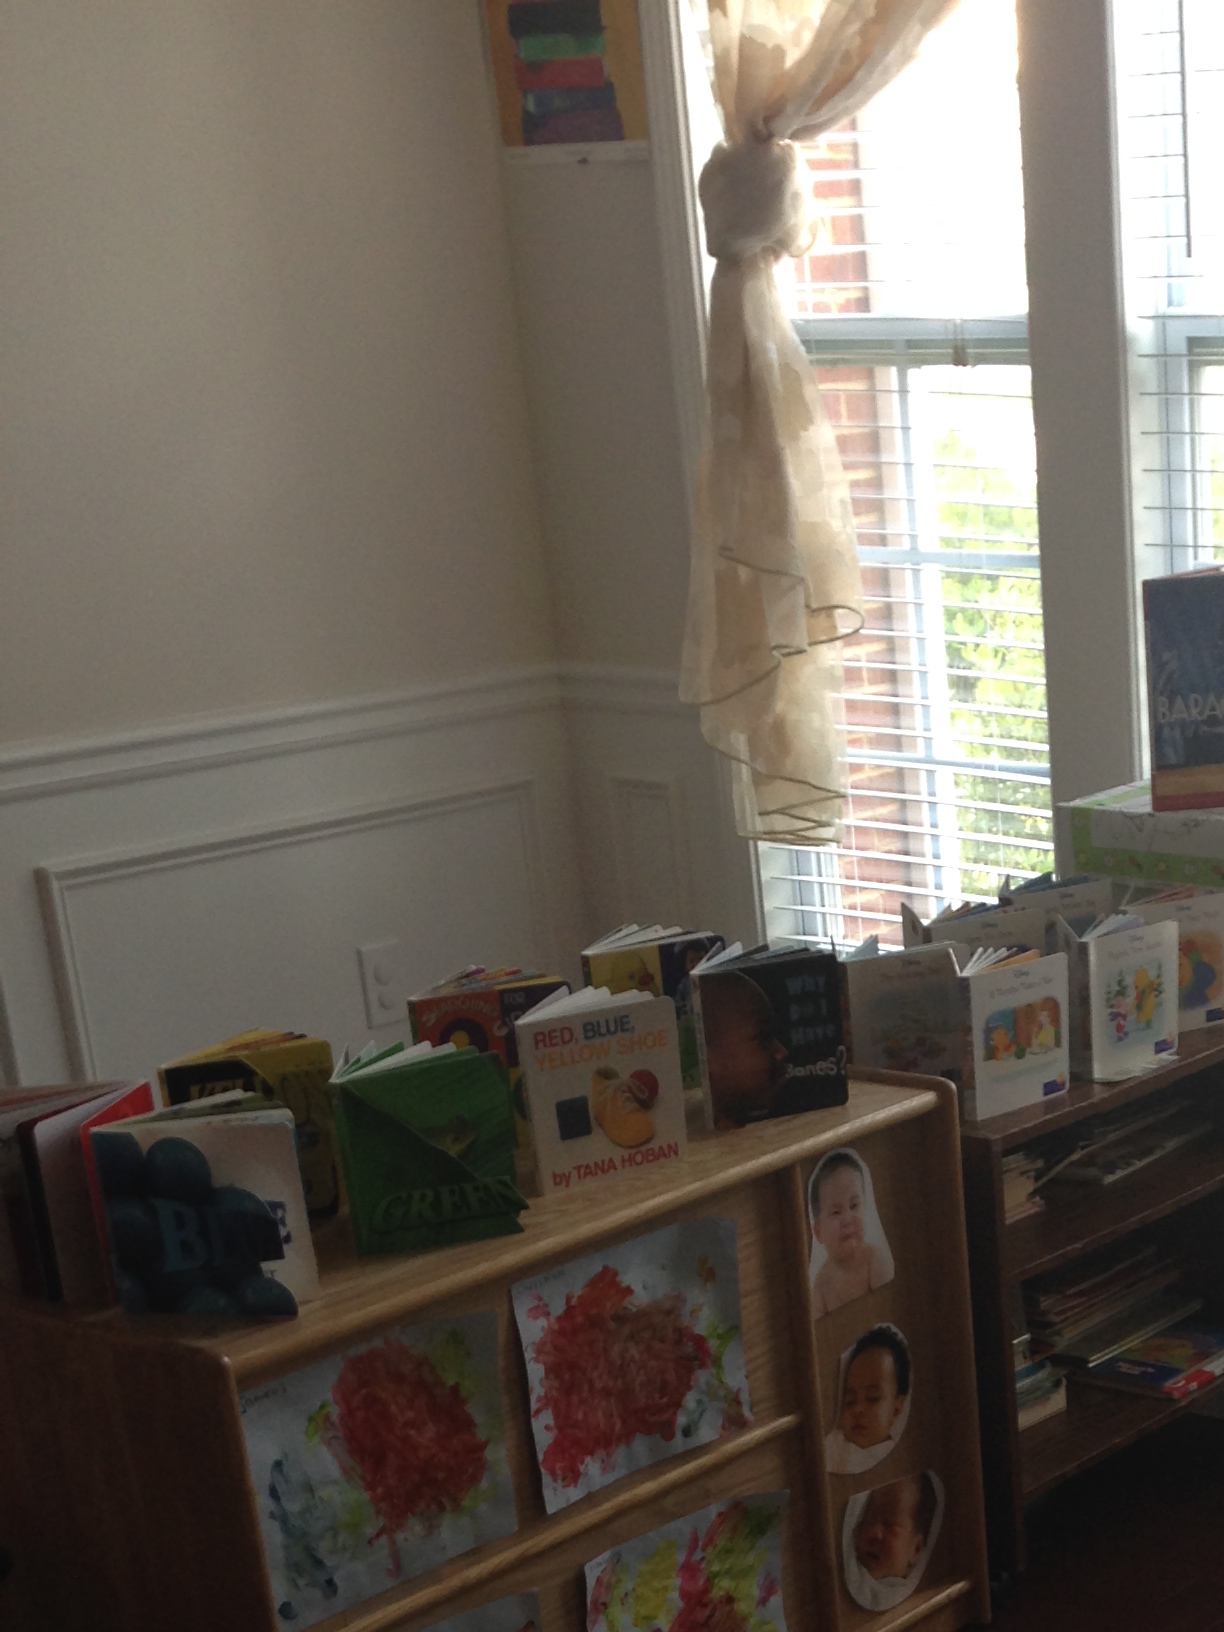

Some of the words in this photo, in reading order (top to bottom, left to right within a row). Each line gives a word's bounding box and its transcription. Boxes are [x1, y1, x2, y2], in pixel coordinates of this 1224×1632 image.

[533, 1026, 578, 1050] RED,
[582, 1014, 635, 1041] BLUE,
[534, 1039, 611, 1071] YELLOW
[616, 1028, 668, 1055] SHOE
[552, 1171, 571, 1188] by
[573, 1158, 617, 1180] TANA
[620, 1142, 679, 1168] HOBAN
[370, 1175, 527, 1234] GREEN
[150, 1199, 293, 1274] BLE
